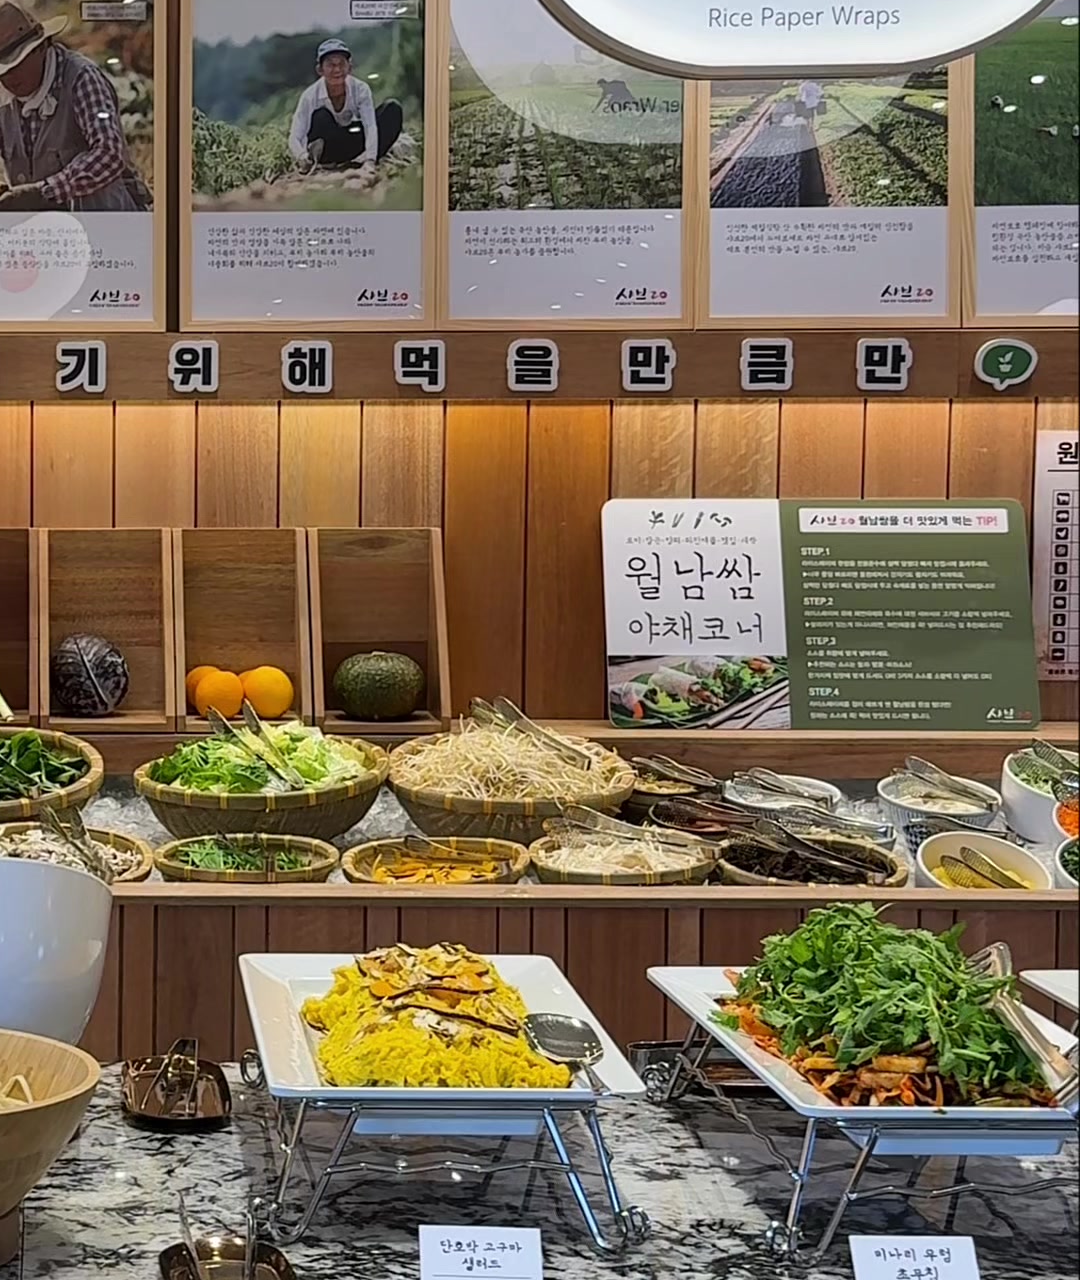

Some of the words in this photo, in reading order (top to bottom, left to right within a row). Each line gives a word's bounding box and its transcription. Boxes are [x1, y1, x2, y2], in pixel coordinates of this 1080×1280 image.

[708, 6, 754, 29] Rice
[760, 6, 825, 33] Paper
[831, 5, 901, 31] Wraps
[903, 515, 913, 526] 더
[916, 515, 948, 526] 맛있게
[951, 515, 973, 526] 먹는
[975, 515, 998, 526] TIP!
[625, 551, 761, 600] 월남쌈
[628, 610, 763, 645] 야채코너
[440, 1238, 479, 1254] 단호박
[483, 1241, 523, 1253] 고구마
[874, 1247, 917, 1262] 미나리
[923, 1247, 952, 1263] 우렁
